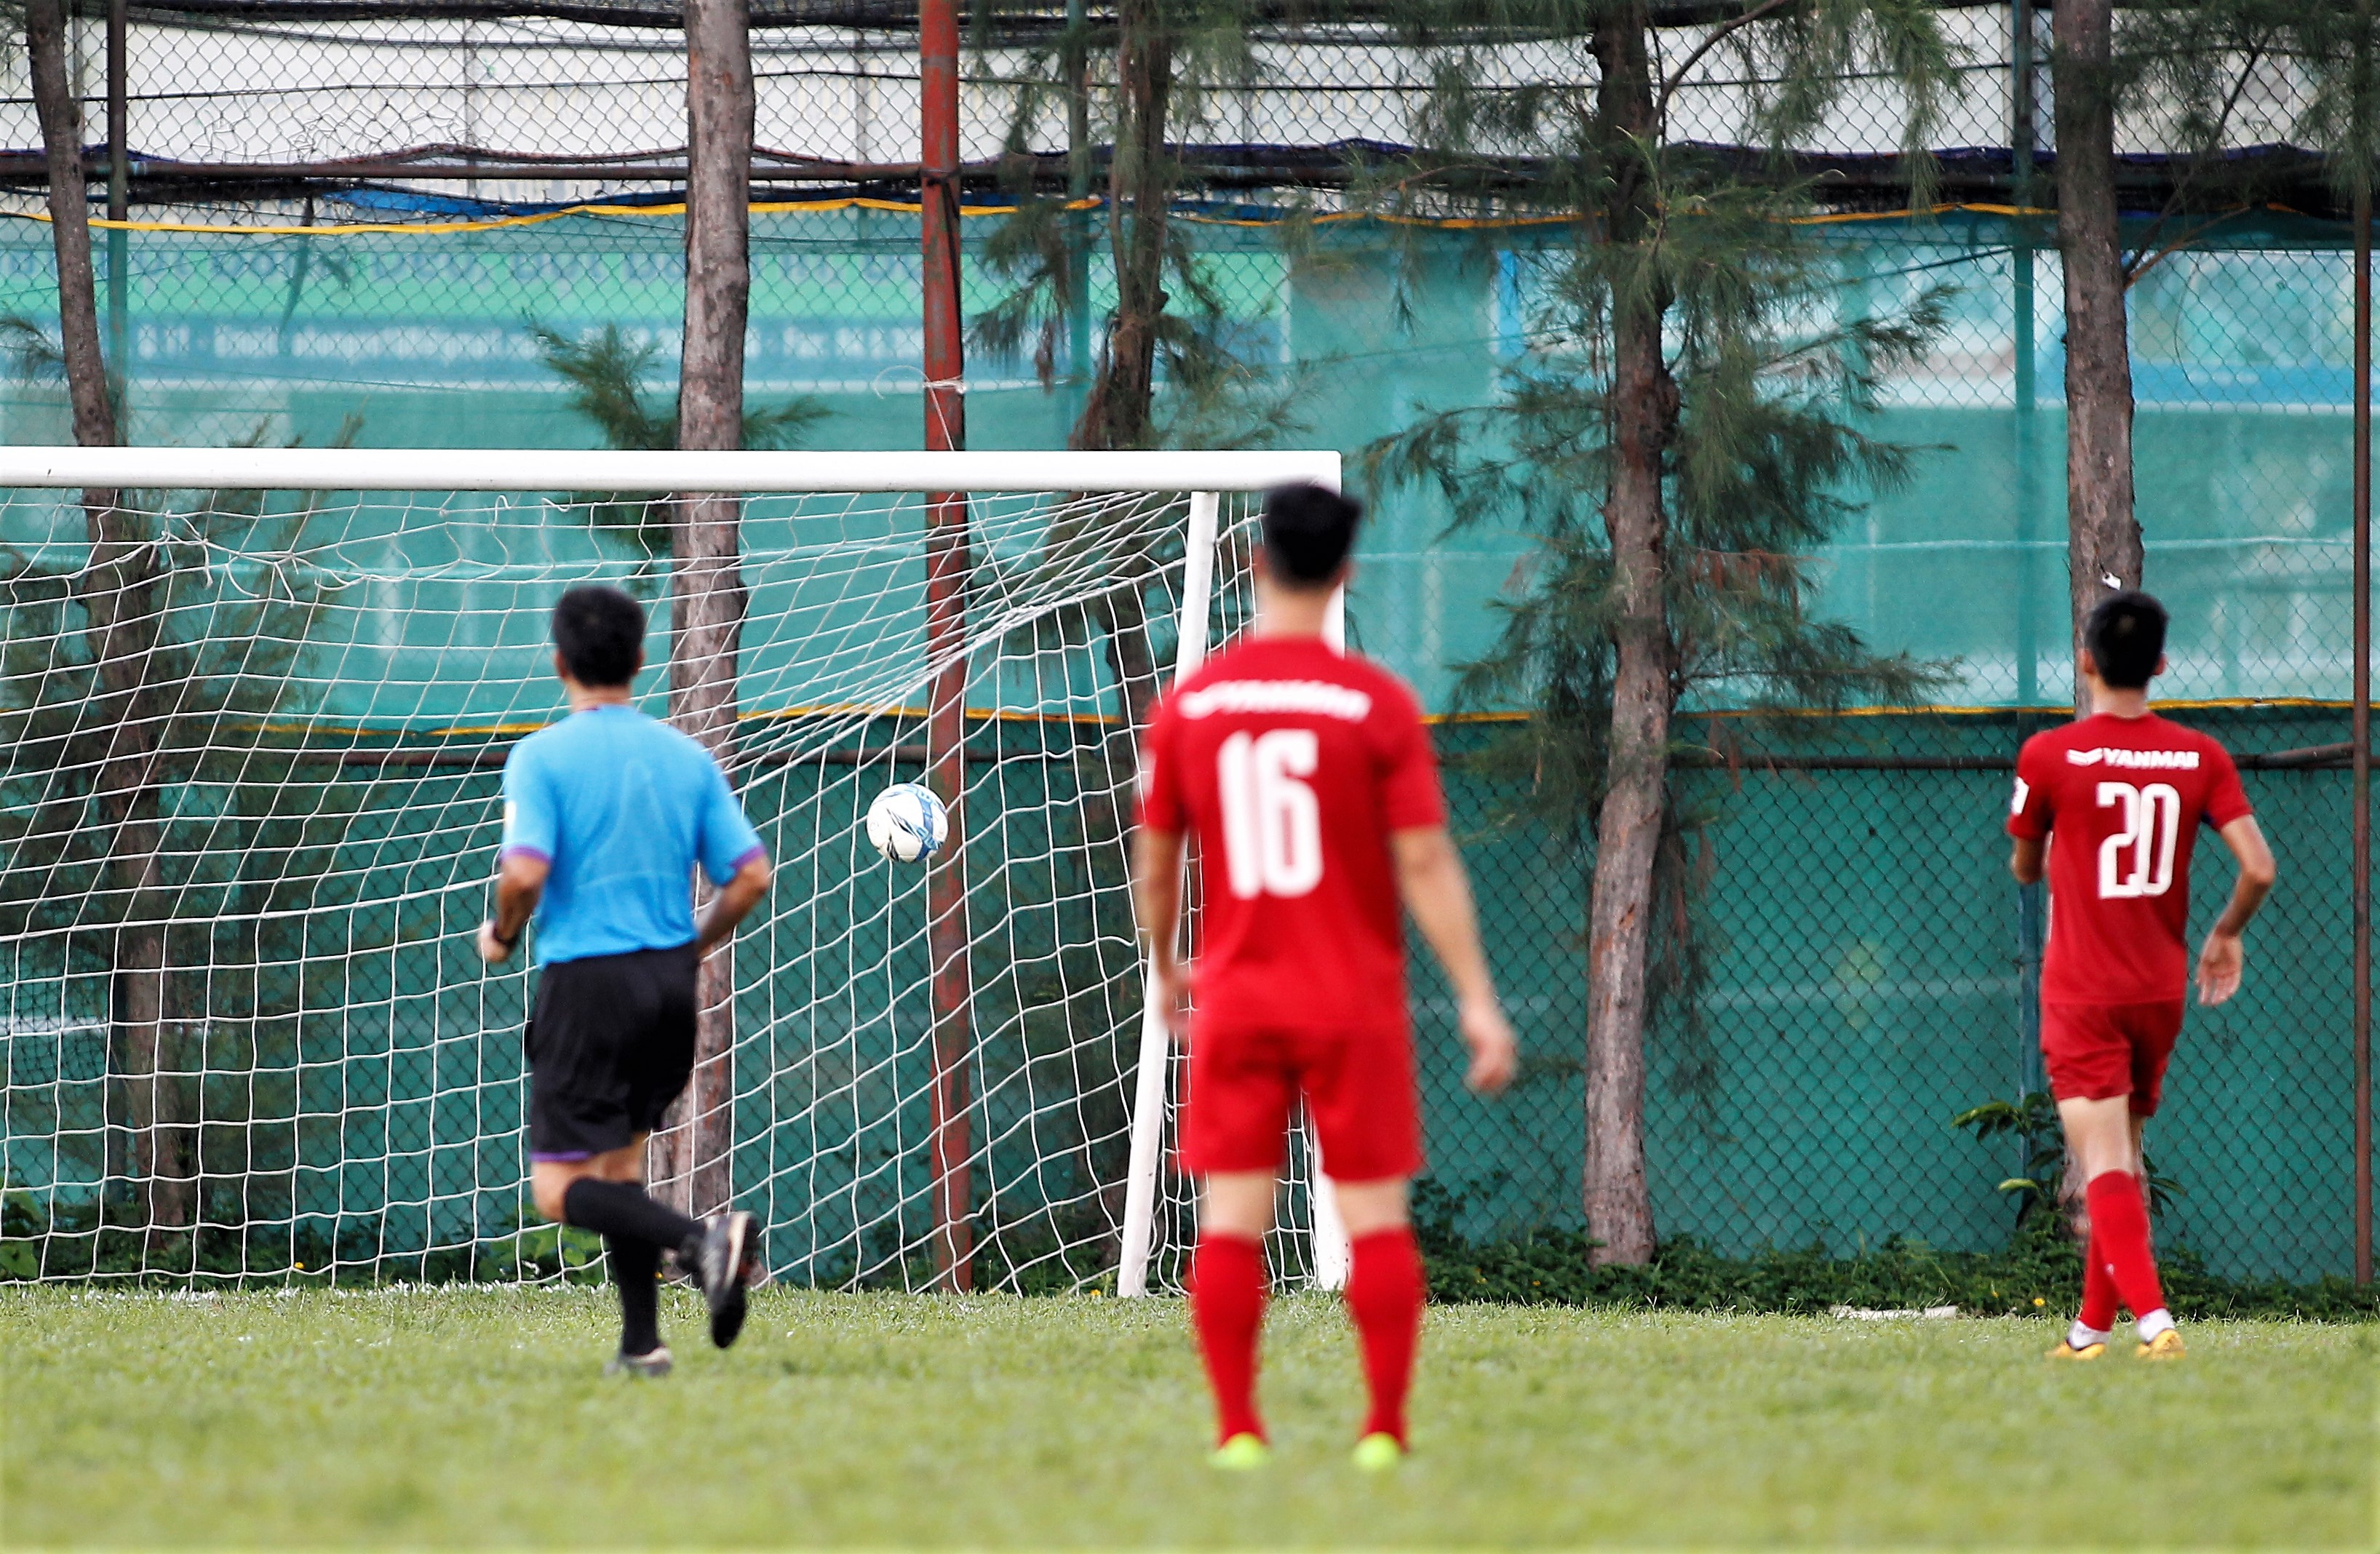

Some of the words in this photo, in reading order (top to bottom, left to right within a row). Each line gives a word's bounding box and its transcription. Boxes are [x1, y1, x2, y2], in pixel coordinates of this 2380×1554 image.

[1217, 729, 1324, 899] 16
[2103, 747, 2200, 769] YANMAR
[2096, 781, 2180, 899] 20
